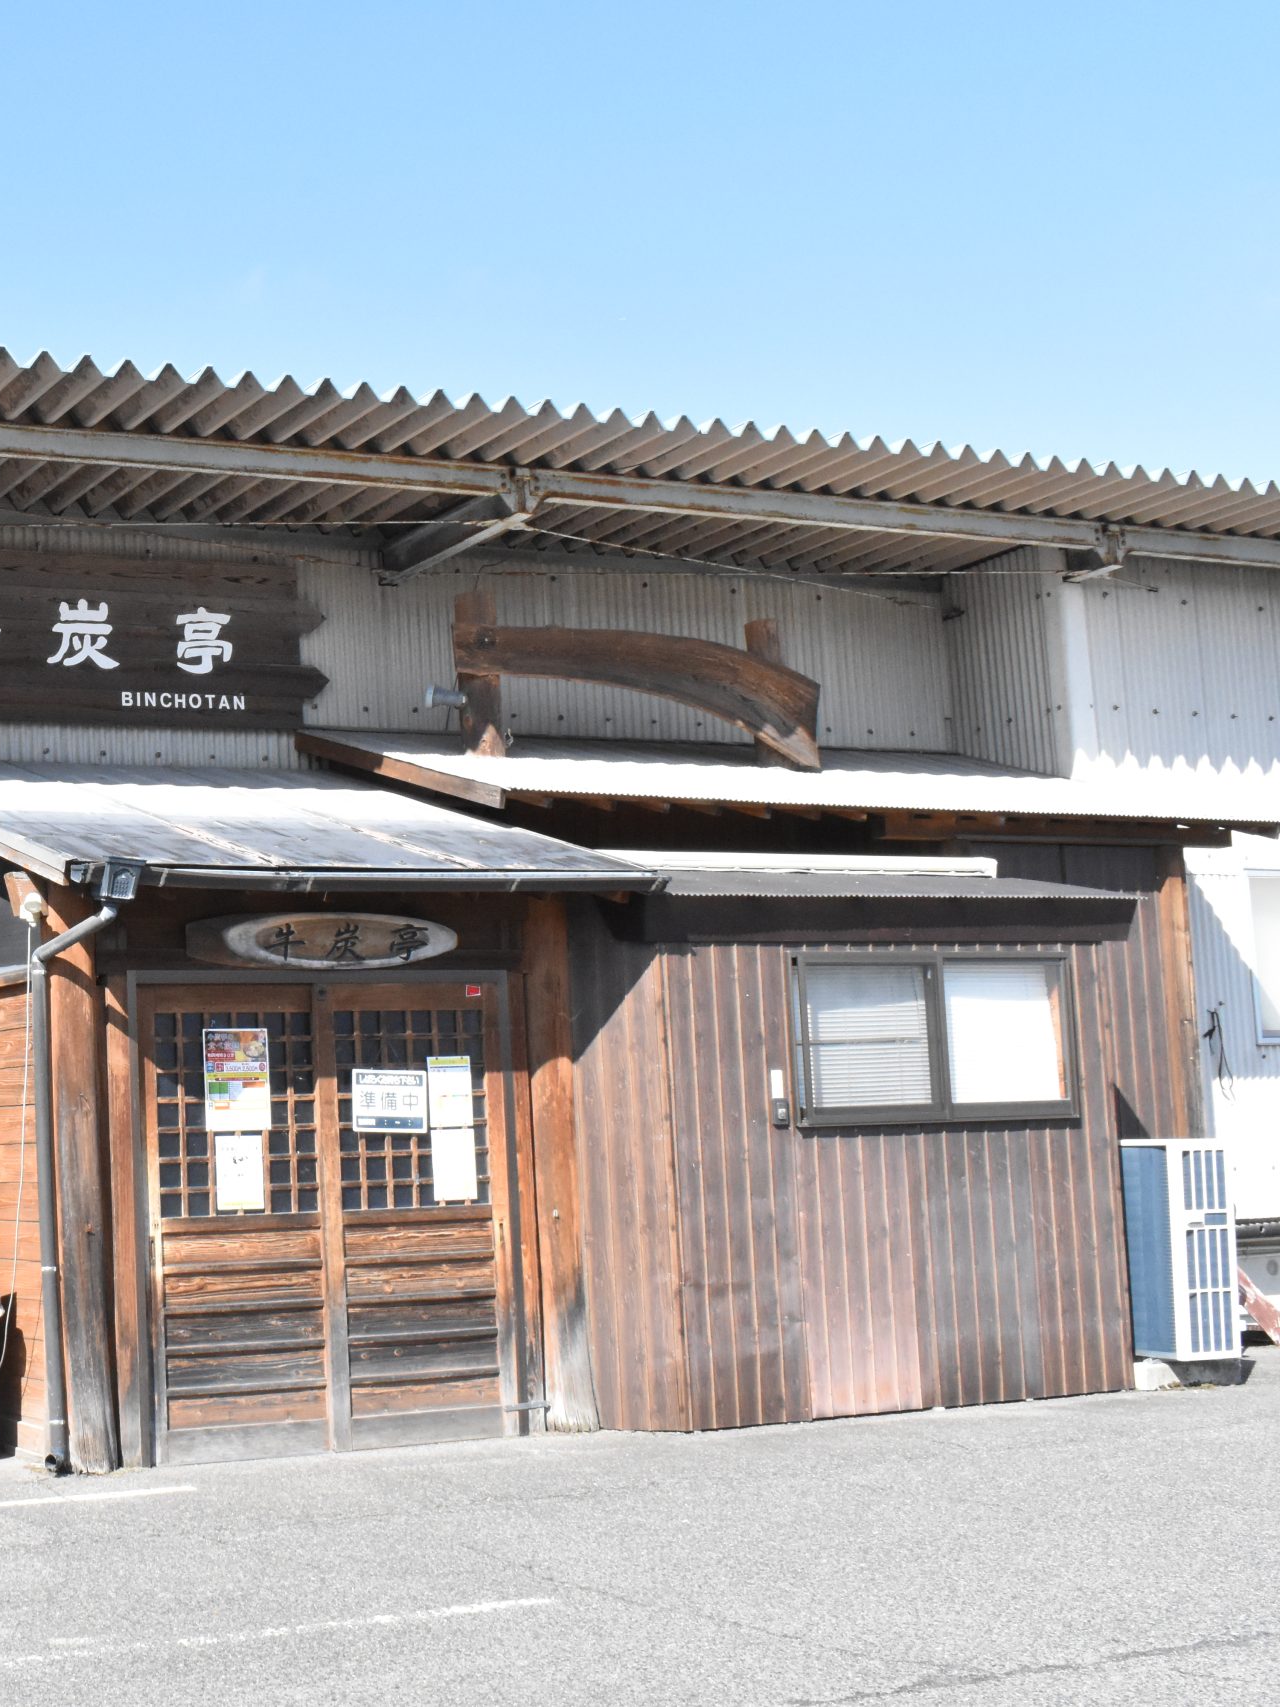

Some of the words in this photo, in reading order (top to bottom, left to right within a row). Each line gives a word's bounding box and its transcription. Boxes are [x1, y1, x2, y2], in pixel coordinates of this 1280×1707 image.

[121, 692, 246, 711] BINCHOTAN
[265, 923, 429, 960] 牛炭亭
[359, 1090, 418, 1111] 準備中
